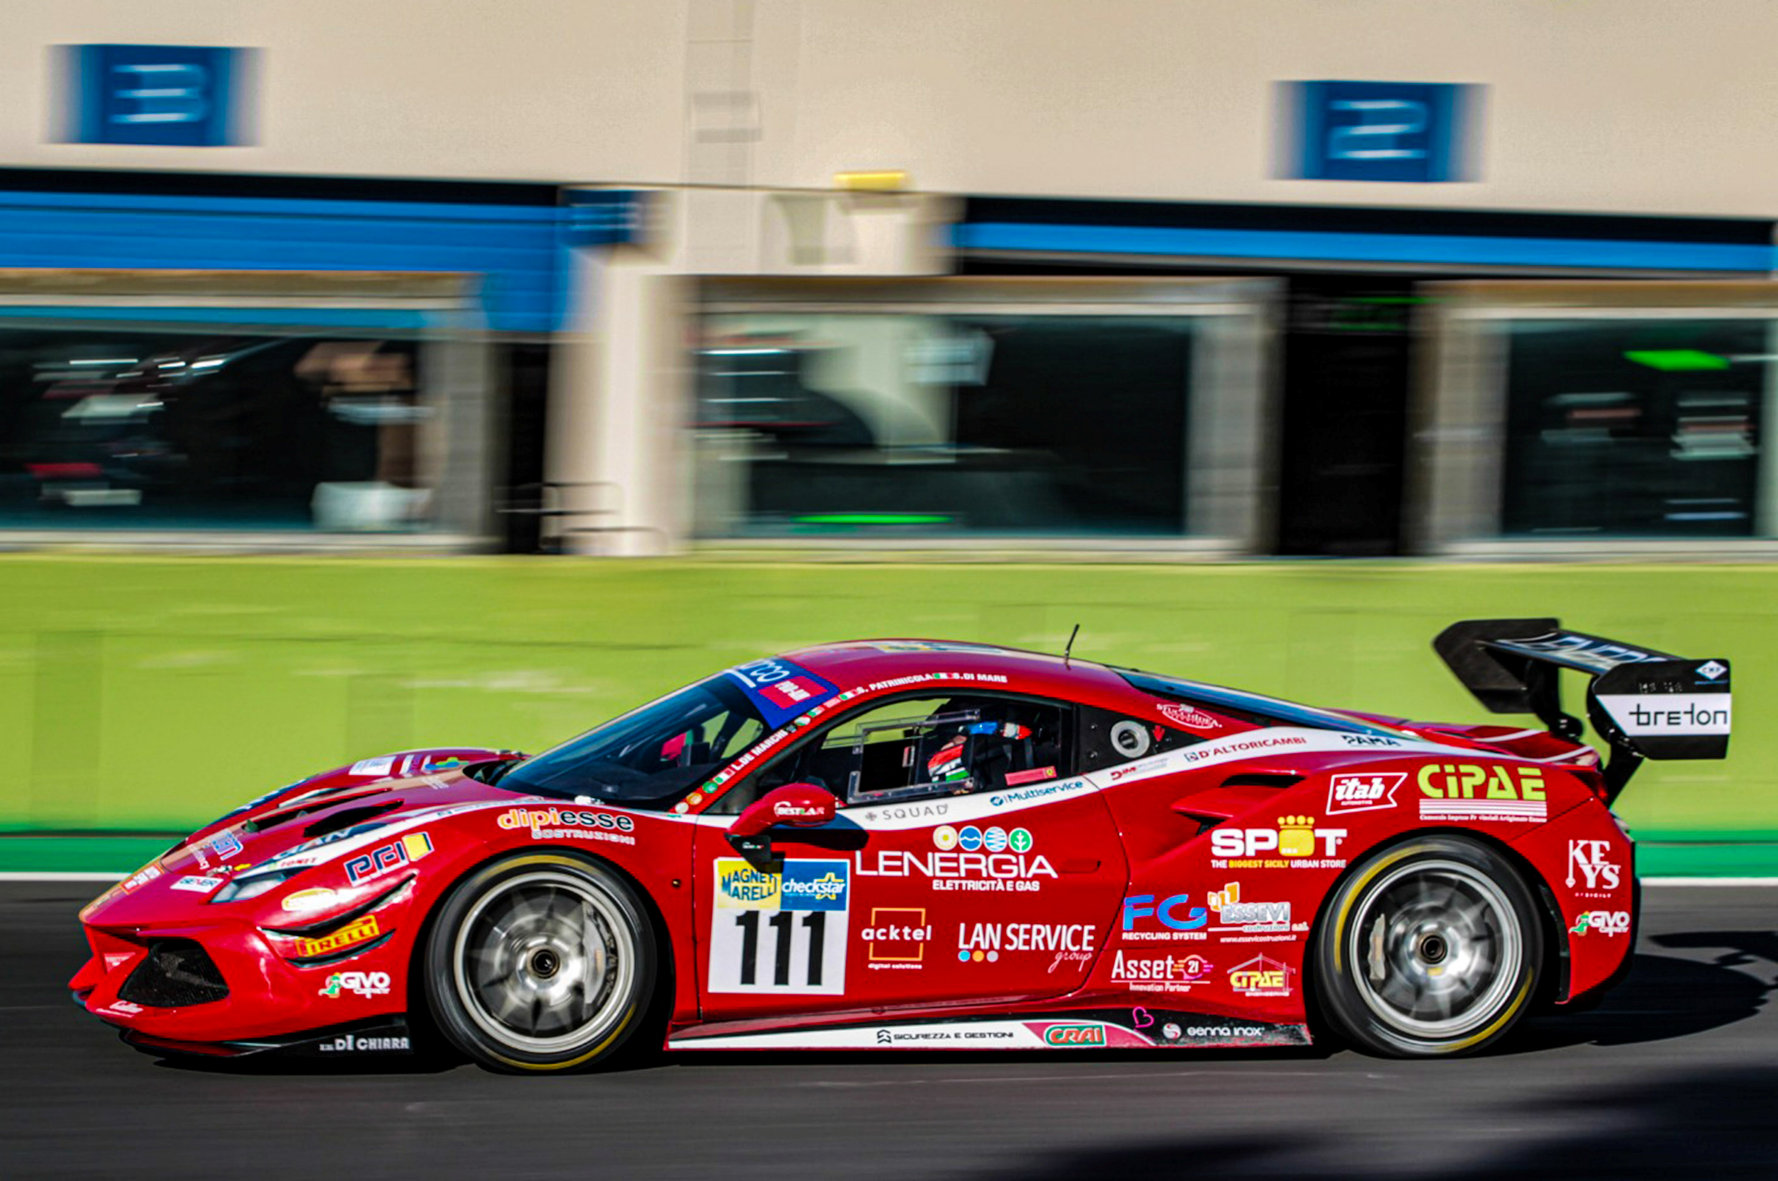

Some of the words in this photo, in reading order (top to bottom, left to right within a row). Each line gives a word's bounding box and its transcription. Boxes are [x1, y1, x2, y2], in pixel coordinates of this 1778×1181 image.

[112, 64, 206, 124] 3
[1328, 100, 1426, 159] 2
[977, 673, 1008, 683] MARE
[1629, 703, 1728, 726] breton
[752, 729, 788, 756] MARCHI
[1007, 780, 1084, 801] Multiservice
[498, 807, 634, 832] dipiesse
[882, 803, 948, 820] SQUAD
[855, 850, 1058, 879] LENERGIA
[1211, 860, 1228, 869] THE
[1229, 860, 1263, 869] BIGGEST
[1264, 860, 1289, 869] SICILY
[1290, 860, 1320, 869] URBAN
[1320, 860, 1347, 869] STORE
[782, 878, 845, 893] checkstar
[932, 879, 1003, 891] ELETTRICITÀ
[1006, 881, 1014, 891] E
[1015, 881, 1040, 891] GAS
[1122, 894, 1207, 931] FG
[296, 917, 380, 956] PIRELLI
[861, 925, 932, 940] acktel
[958, 923, 1001, 950] LAN
[1005, 923, 1096, 951] SERVICE
[1122, 932, 1171, 940] RECYCLING
[1172, 932, 1207, 940] SYSTEM
[735, 910, 826, 986] 111
[1048, 951, 1093, 973] group
[1111, 950, 1175, 979] Asset
[1129, 981, 1164, 992] Innovation
[1165, 981, 1191, 993] Partner
[356, 1037, 409, 1050] CHIARA
[893, 1031, 951, 1041] SICUREZZA
[964, 1031, 1014, 1039] GESTIONI
[1049, 1027, 1103, 1043] CRAI
